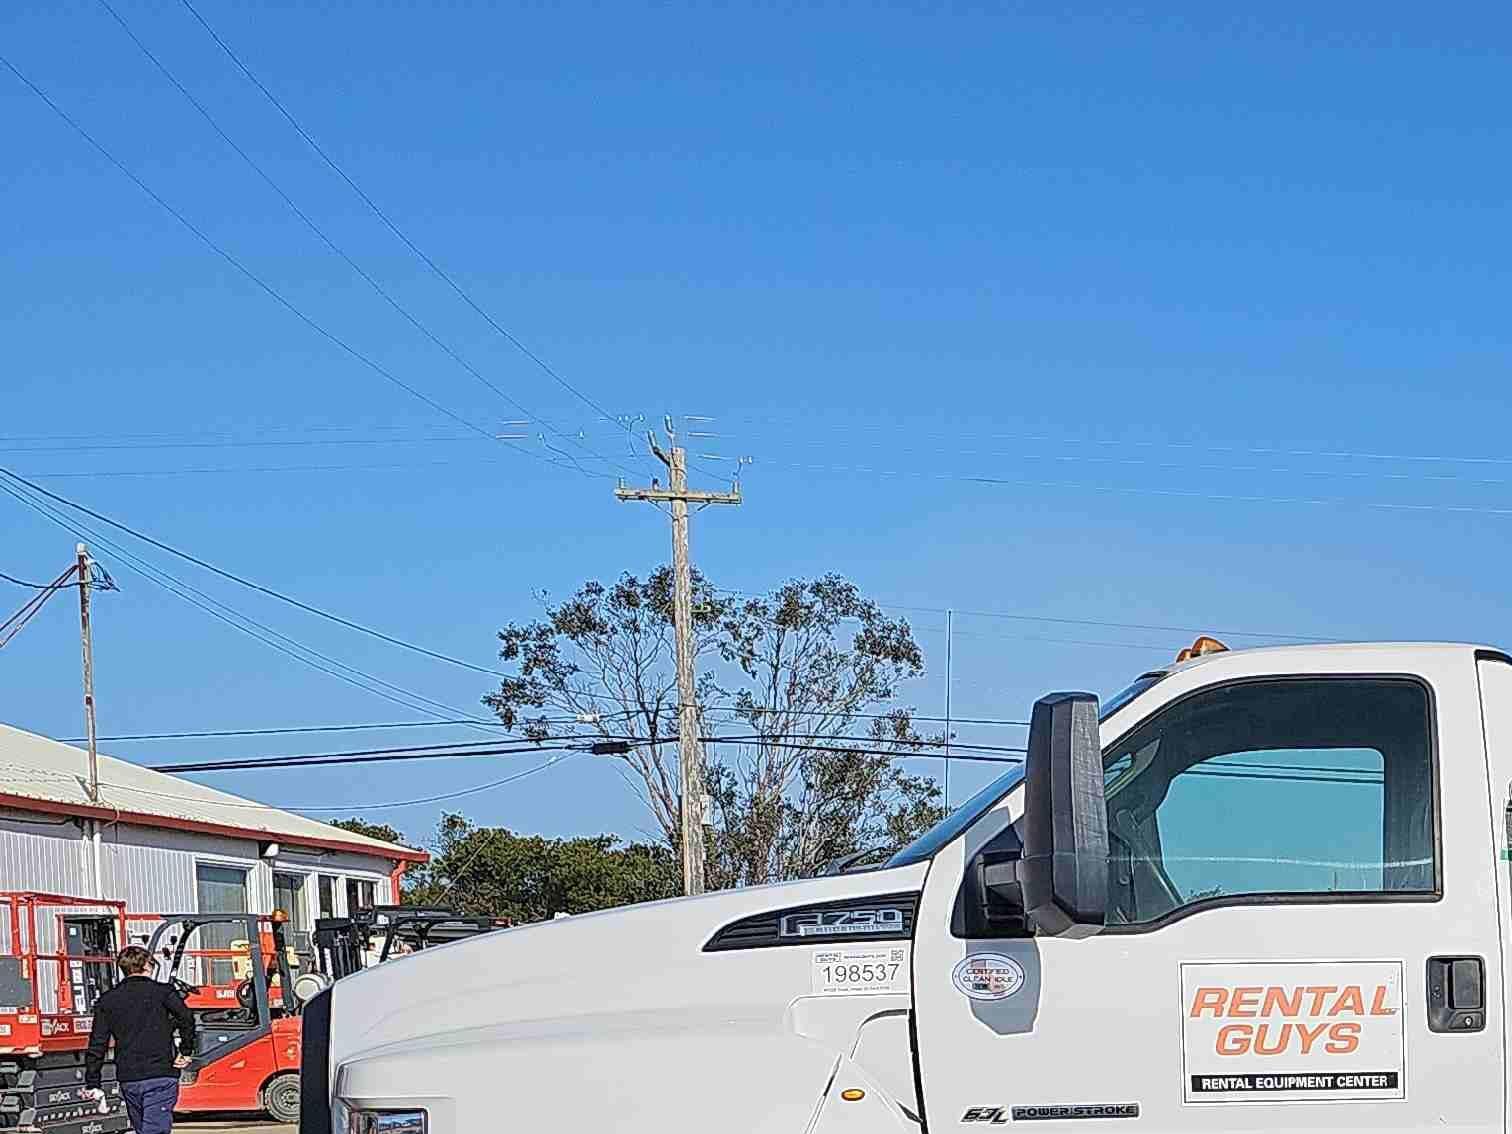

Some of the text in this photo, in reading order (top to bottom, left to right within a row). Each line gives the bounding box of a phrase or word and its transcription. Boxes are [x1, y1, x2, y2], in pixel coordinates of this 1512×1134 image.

[822, 963, 900, 983] 198537
[1190, 985, 1398, 1018] RENTAL
[1215, 1022, 1361, 1056] GUYS
[1201, 1074, 1388, 1090] RENTAL EQUIPMENT CENTER
